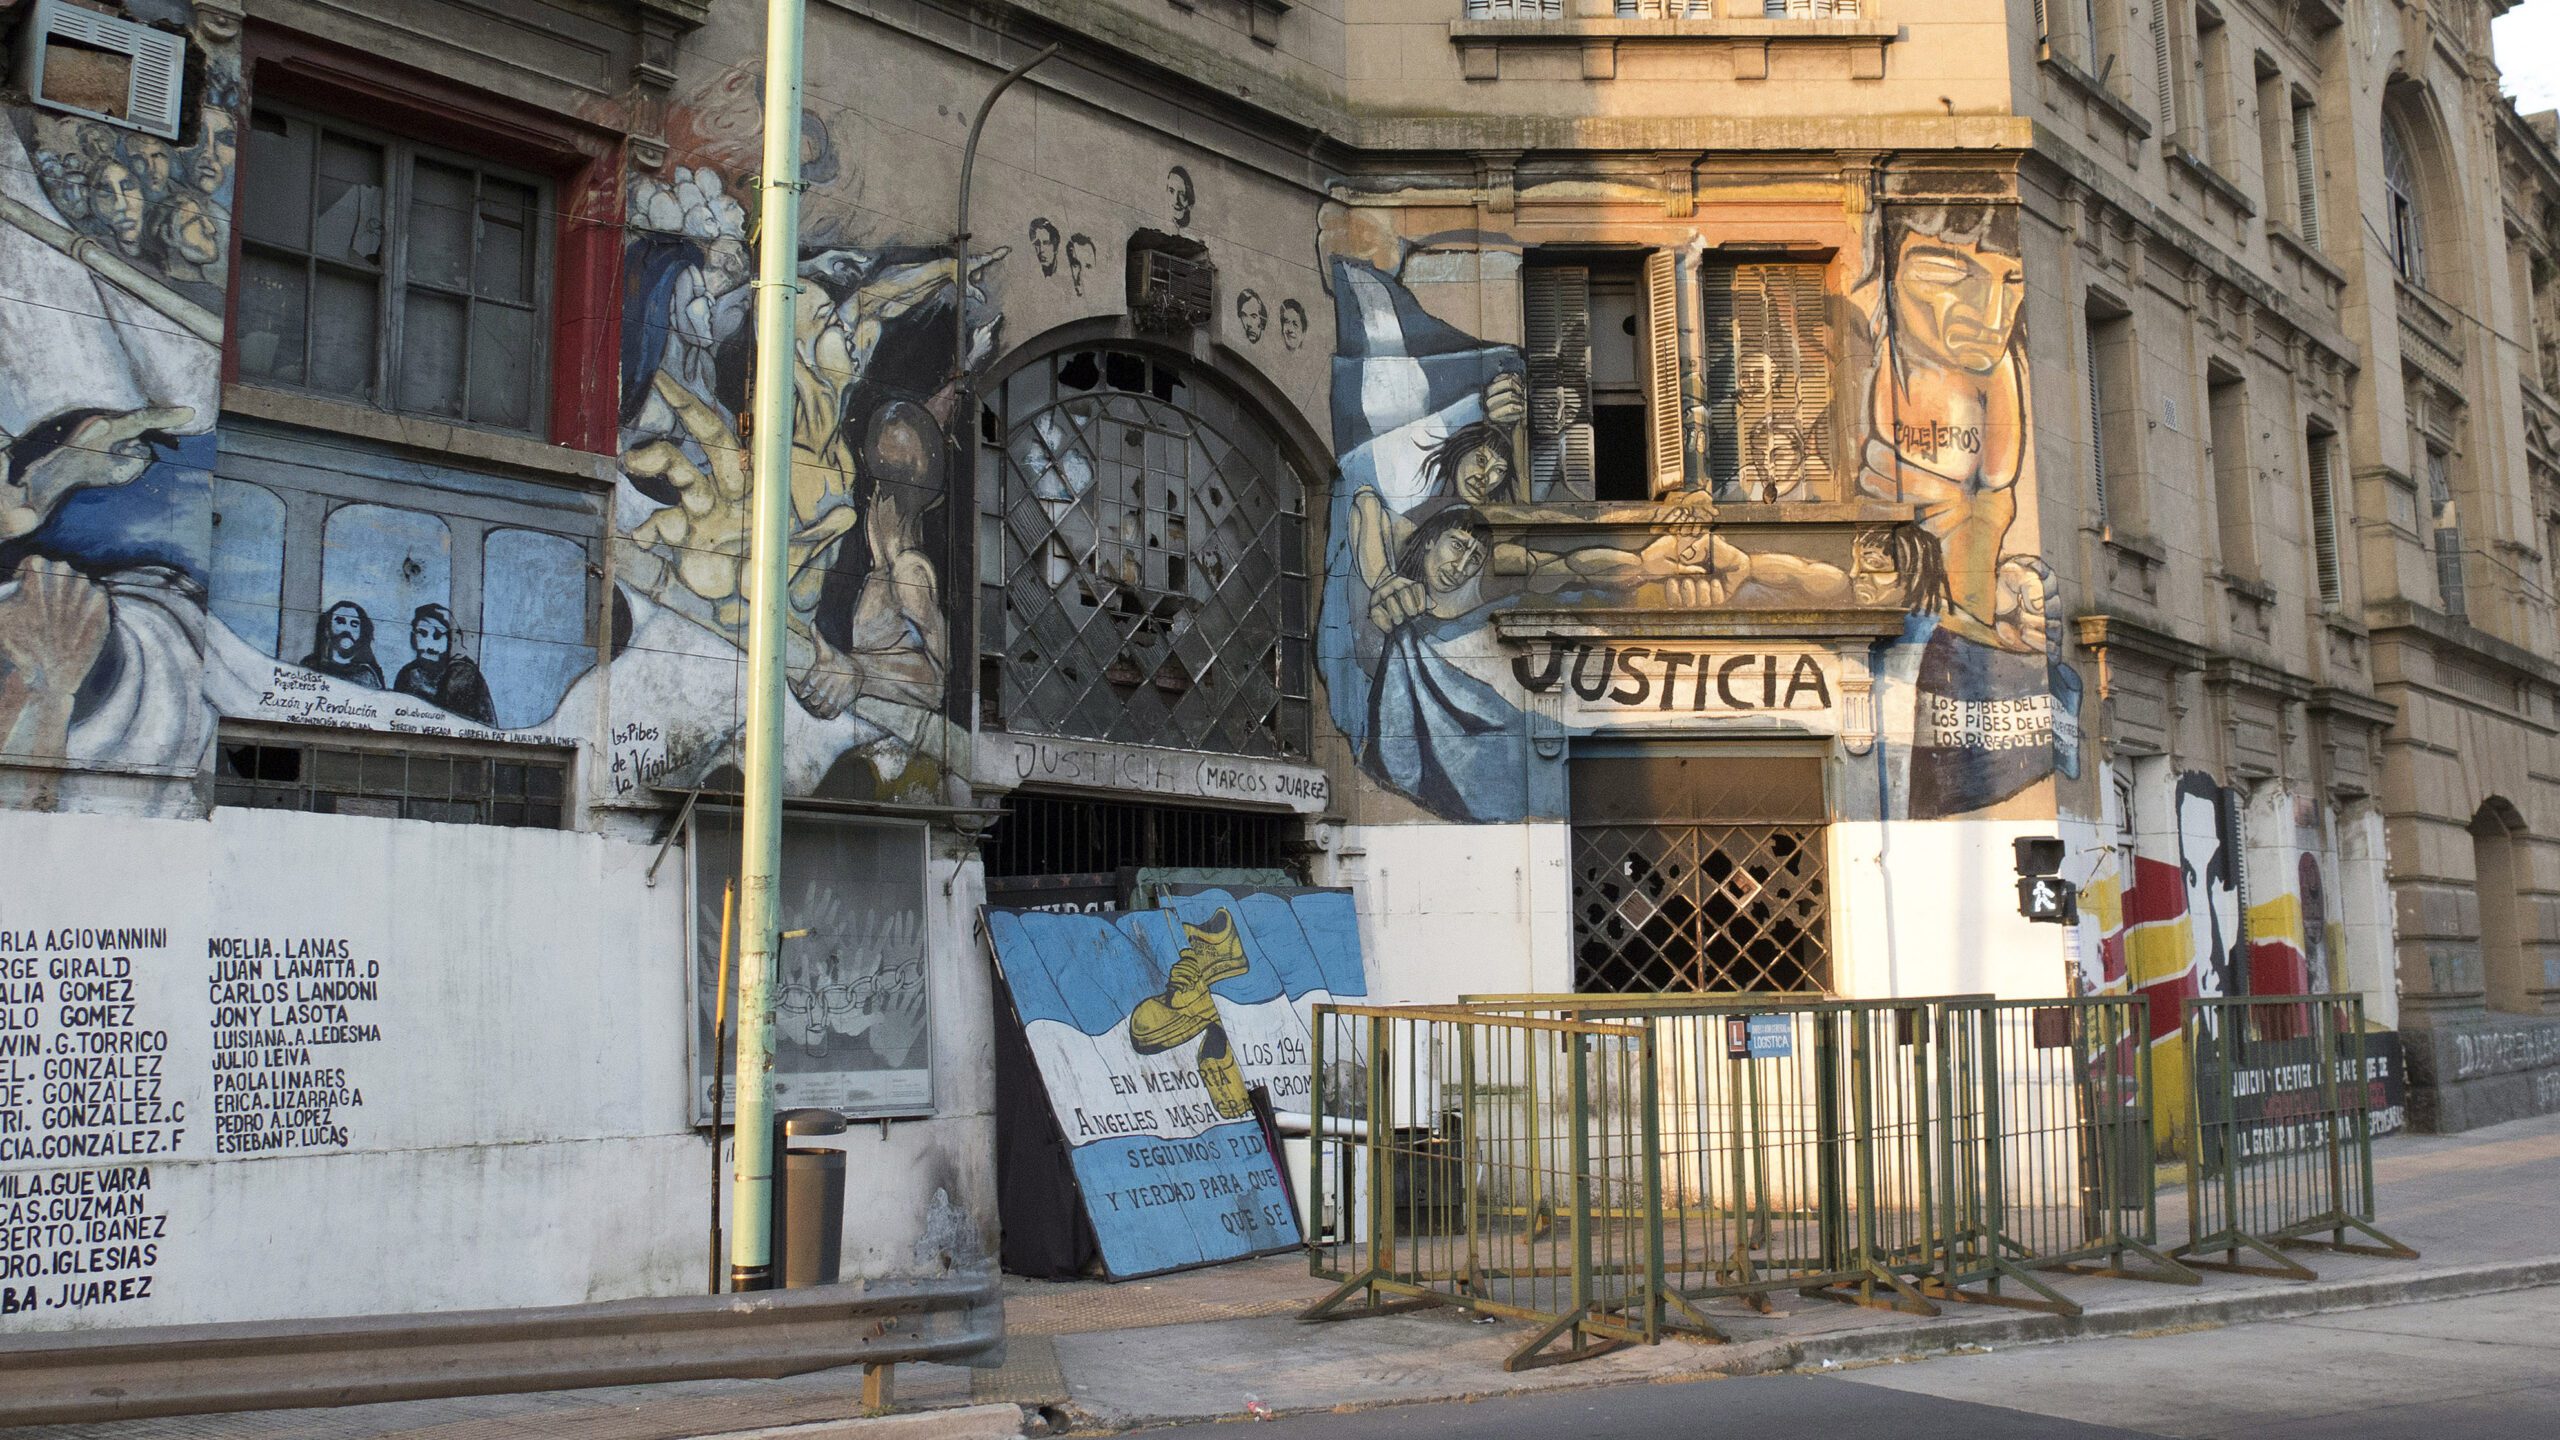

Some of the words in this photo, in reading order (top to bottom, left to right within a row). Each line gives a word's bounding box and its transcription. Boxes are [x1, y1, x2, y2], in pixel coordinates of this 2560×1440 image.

[1512, 630, 1832, 711] JUSTICIA
[301, 701, 313, 716] y
[315, 696, 378, 718] Revolución
[1931, 693, 1958, 712] LOS
[2014, 695, 2036, 712] DEL
[627, 722, 659, 741] Pibes
[1931, 712, 1958, 728] LOS
[2017, 717, 2033, 730] DE
[1933, 729, 1962, 747] LOS
[2015, 734, 2034, 746] DE
[612, 752, 626, 772] de
[1014, 741, 1176, 792] JUSTICIA
[1, 930, 38, 951] RLA
[50, 956, 131, 979] GIRALD
[209, 960, 262, 983] JUAN
[59, 979, 135, 1002] GOMEZ
[210, 982, 289, 1004] CARLOS
[297, 981, 378, 1003] LANDONI
[60, 1004, 135, 1028] GOMEZ
[210, 1006, 262, 1028] JONY
[271, 1004, 348, 1026] LASOTA
[212, 1050, 258, 1070] JULIO
[265, 1048, 311, 1068] LEIVA
[1243, 1043, 1273, 1066] LOS
[1277, 1036, 1307, 1065] 194
[214, 1071, 268, 1092] PAOLA
[272, 1068, 345, 1089] LINARES
[1109, 1074, 1138, 1095] EN
[1142, 1066, 1232, 1094] MEMORIA
[1273, 1075, 1327, 1097] CROM
[216, 1113, 263, 1134] PEDRO
[217, 1131, 282, 1153] ESTEBAN
[302, 1126, 348, 1147] LUCAS
[1128, 1141, 1221, 1169] SEGUIMOS
[1228, 1134, 1266, 1158] PID
[1106, 1192, 1120, 1211] Y
[1126, 1181, 1196, 1209] VERDAD
[1200, 1173, 1244, 1199] PARA
[1248, 1168, 1278, 1191] QUE
[1221, 1210, 1258, 1236] QUE
[1264, 1203, 1288, 1226] SE
[1, 1286, 37, 1314] BA
